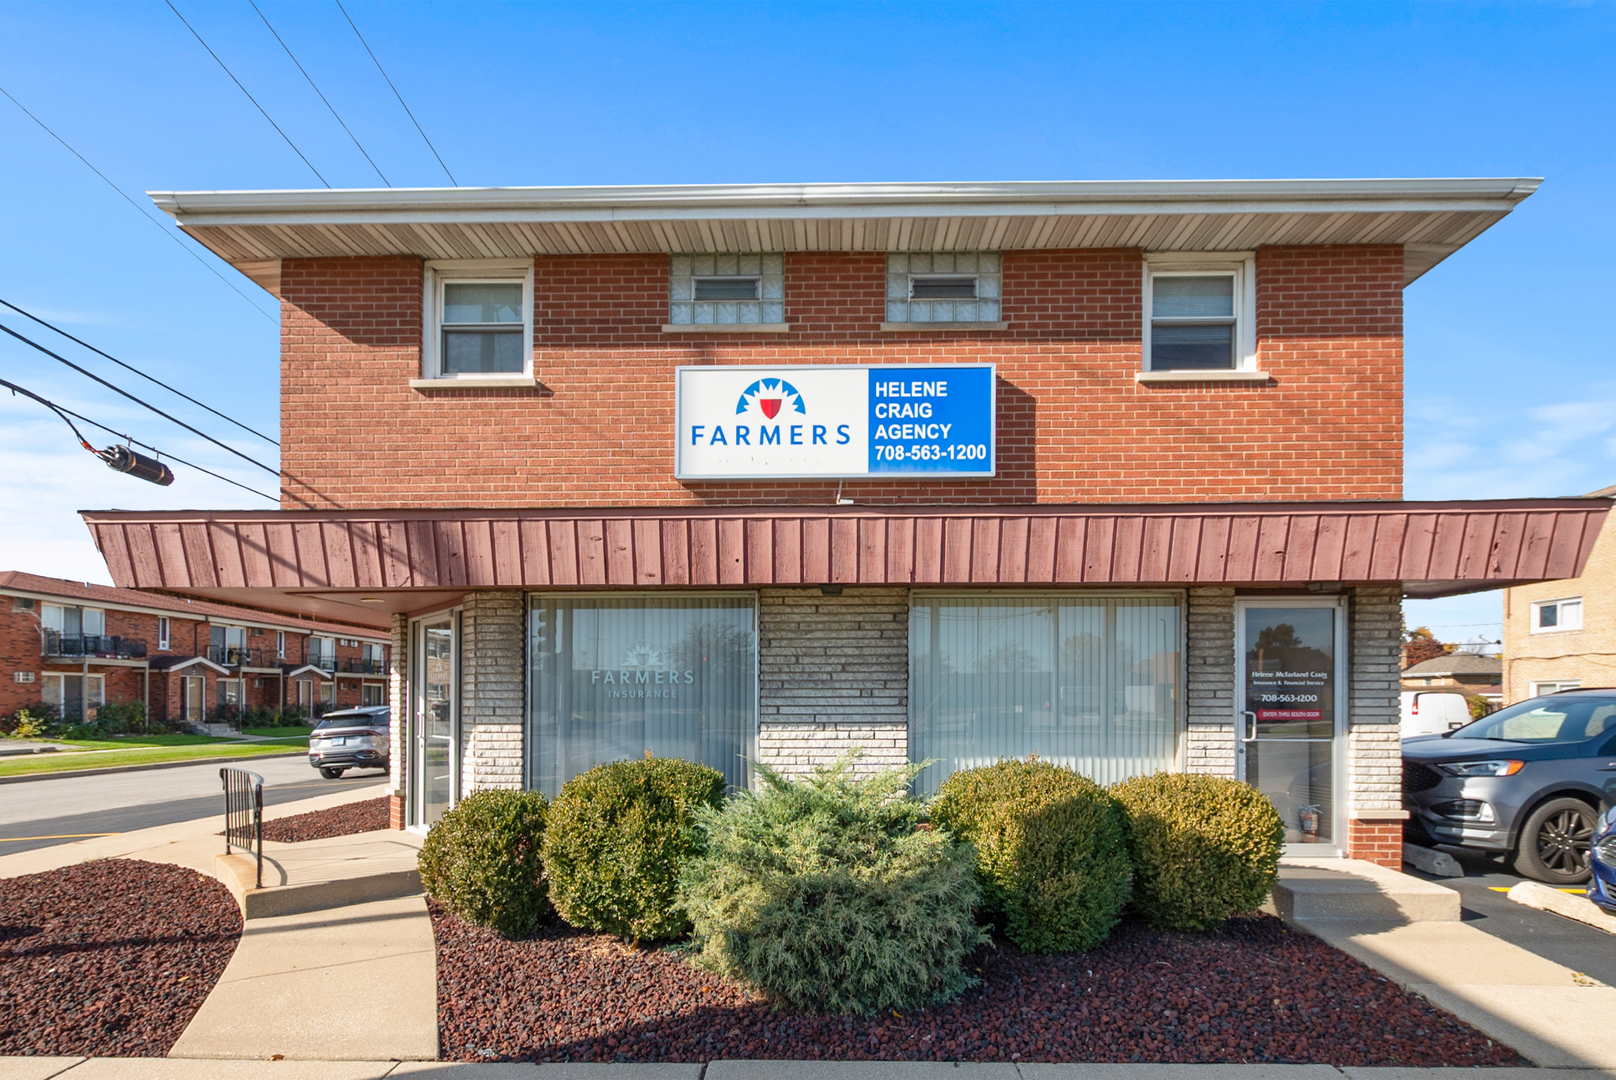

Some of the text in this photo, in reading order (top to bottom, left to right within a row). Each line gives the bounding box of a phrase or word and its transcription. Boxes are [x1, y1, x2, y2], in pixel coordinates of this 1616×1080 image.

[875, 381, 948, 397] HELENE
[875, 402, 933, 419] CRAIG
[691, 424, 851, 446] FARMERS
[874, 423, 952, 440] AGENCY
[875, 444, 987, 461] 708-563-1200
[591, 670, 695, 685] FARMERS
[1310, 671, 1328, 679] Craig
[608, 689, 677, 699] INSURANCE
[1261, 694, 1318, 702] 708-563-1200
